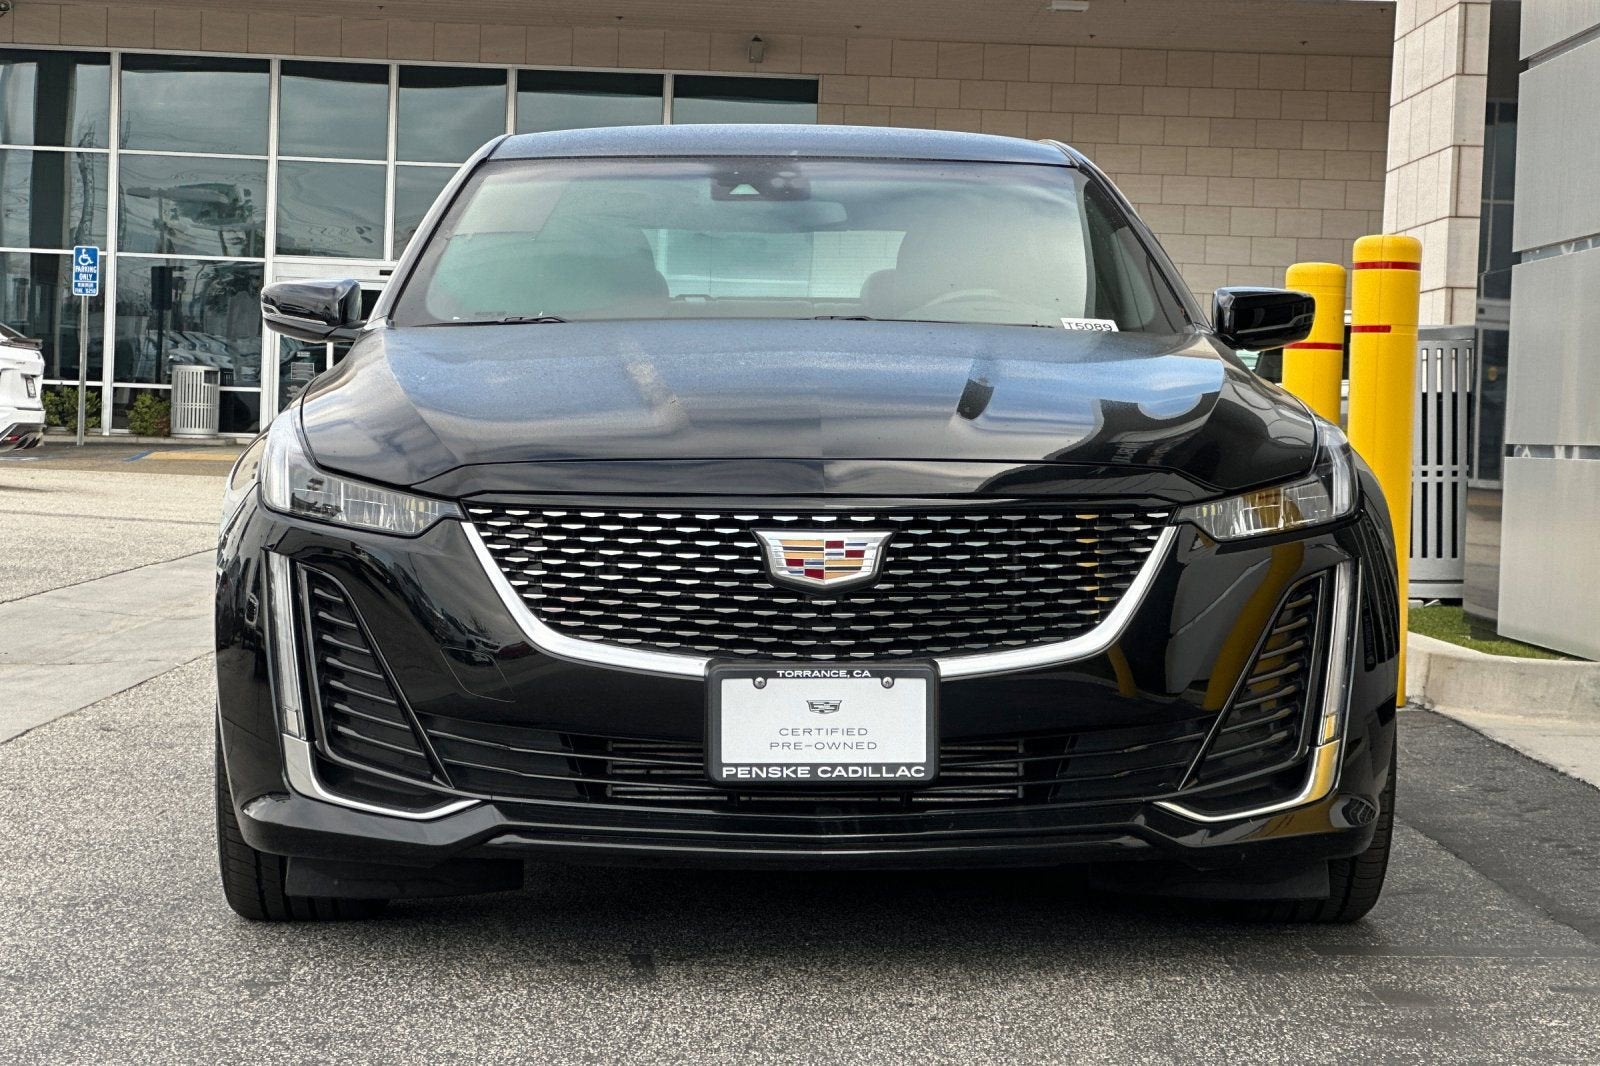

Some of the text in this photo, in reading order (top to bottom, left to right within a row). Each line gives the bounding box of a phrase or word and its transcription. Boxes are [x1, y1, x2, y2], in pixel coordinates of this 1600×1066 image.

[75, 265, 97, 273] PARKING
[79, 273, 93, 281] ONLY
[1065, 321, 1113, 332] T5089
[776, 669, 872, 678] TORRANCE, CA
[778, 727, 869, 737] CERTIFIED
[769, 741, 878, 751] PRE-OWNED
[722, 765, 925, 779] PENSKE CADILLAC
